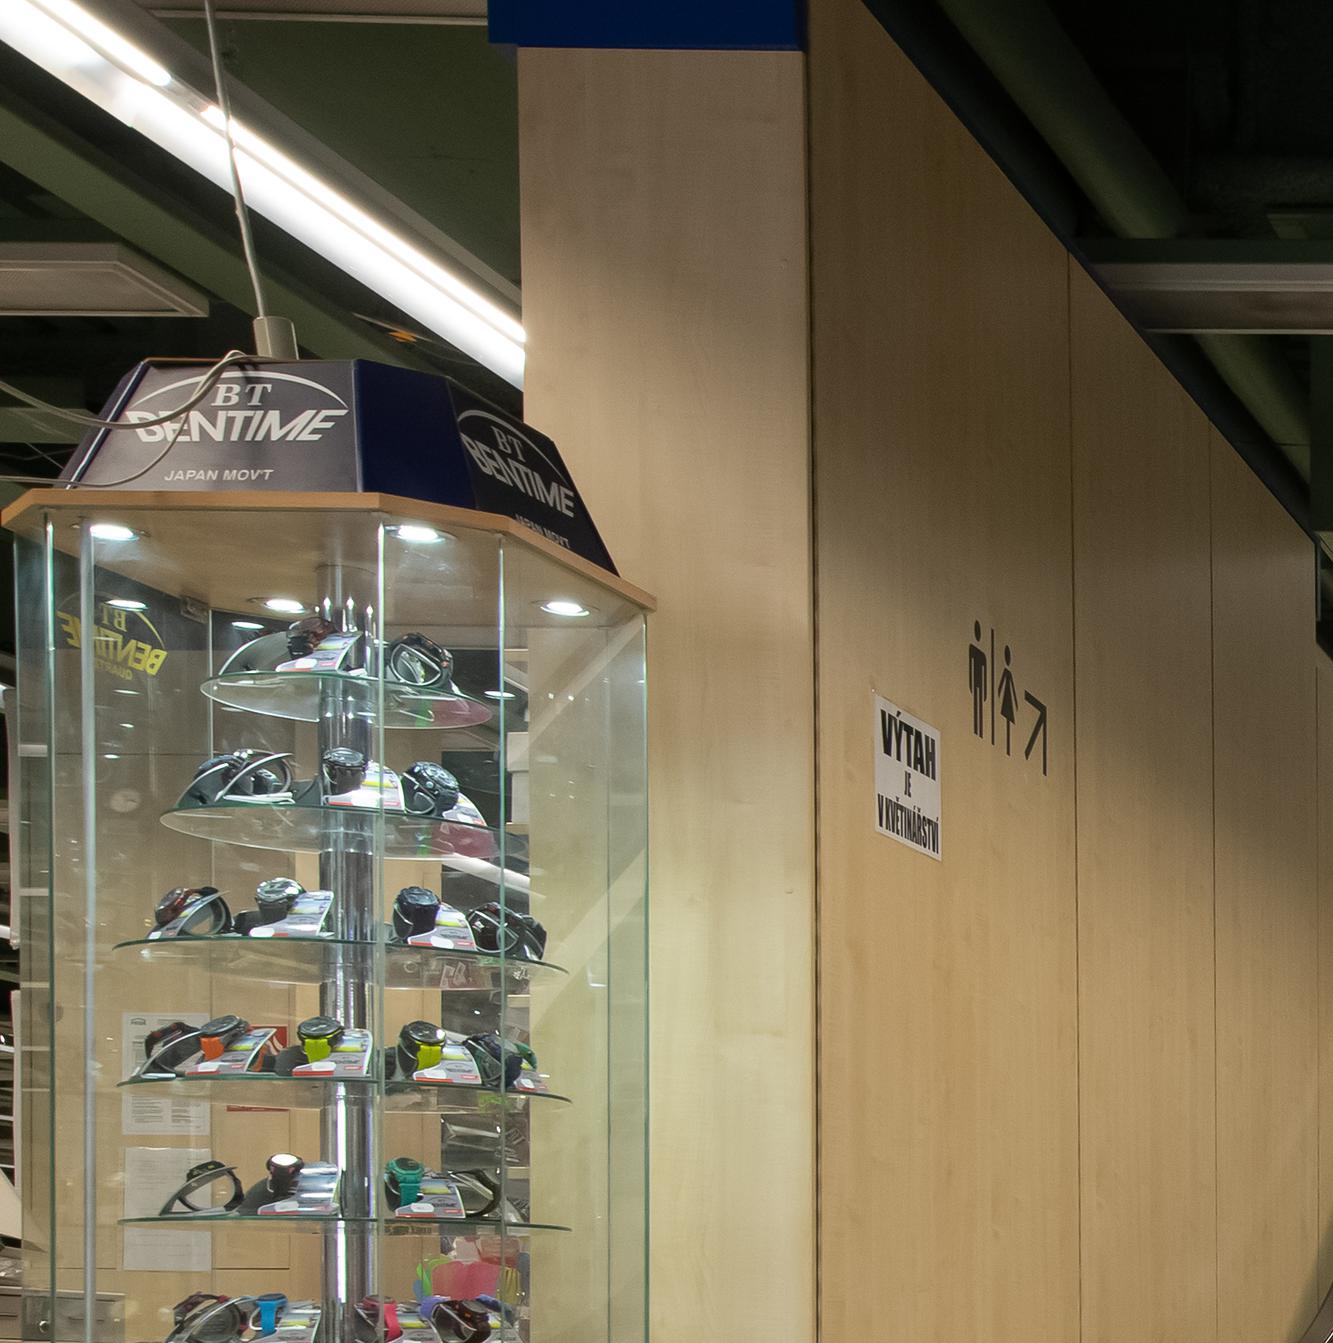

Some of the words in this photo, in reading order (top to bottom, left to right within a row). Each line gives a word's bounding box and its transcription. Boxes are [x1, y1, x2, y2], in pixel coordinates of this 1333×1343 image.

[211, 383, 272, 406] BT
[126, 409, 349, 442] BENTIME
[491, 425, 526, 463] BT
[164, 469, 218, 481] JAPAN
[460, 432, 574, 518] BENTIME
[880, 709, 936, 781] VÝTAH
[904, 770, 912, 798] JE
[877, 793, 885, 828] V
[884, 796, 939, 854] KVĚTINÁŘSTVÍ
